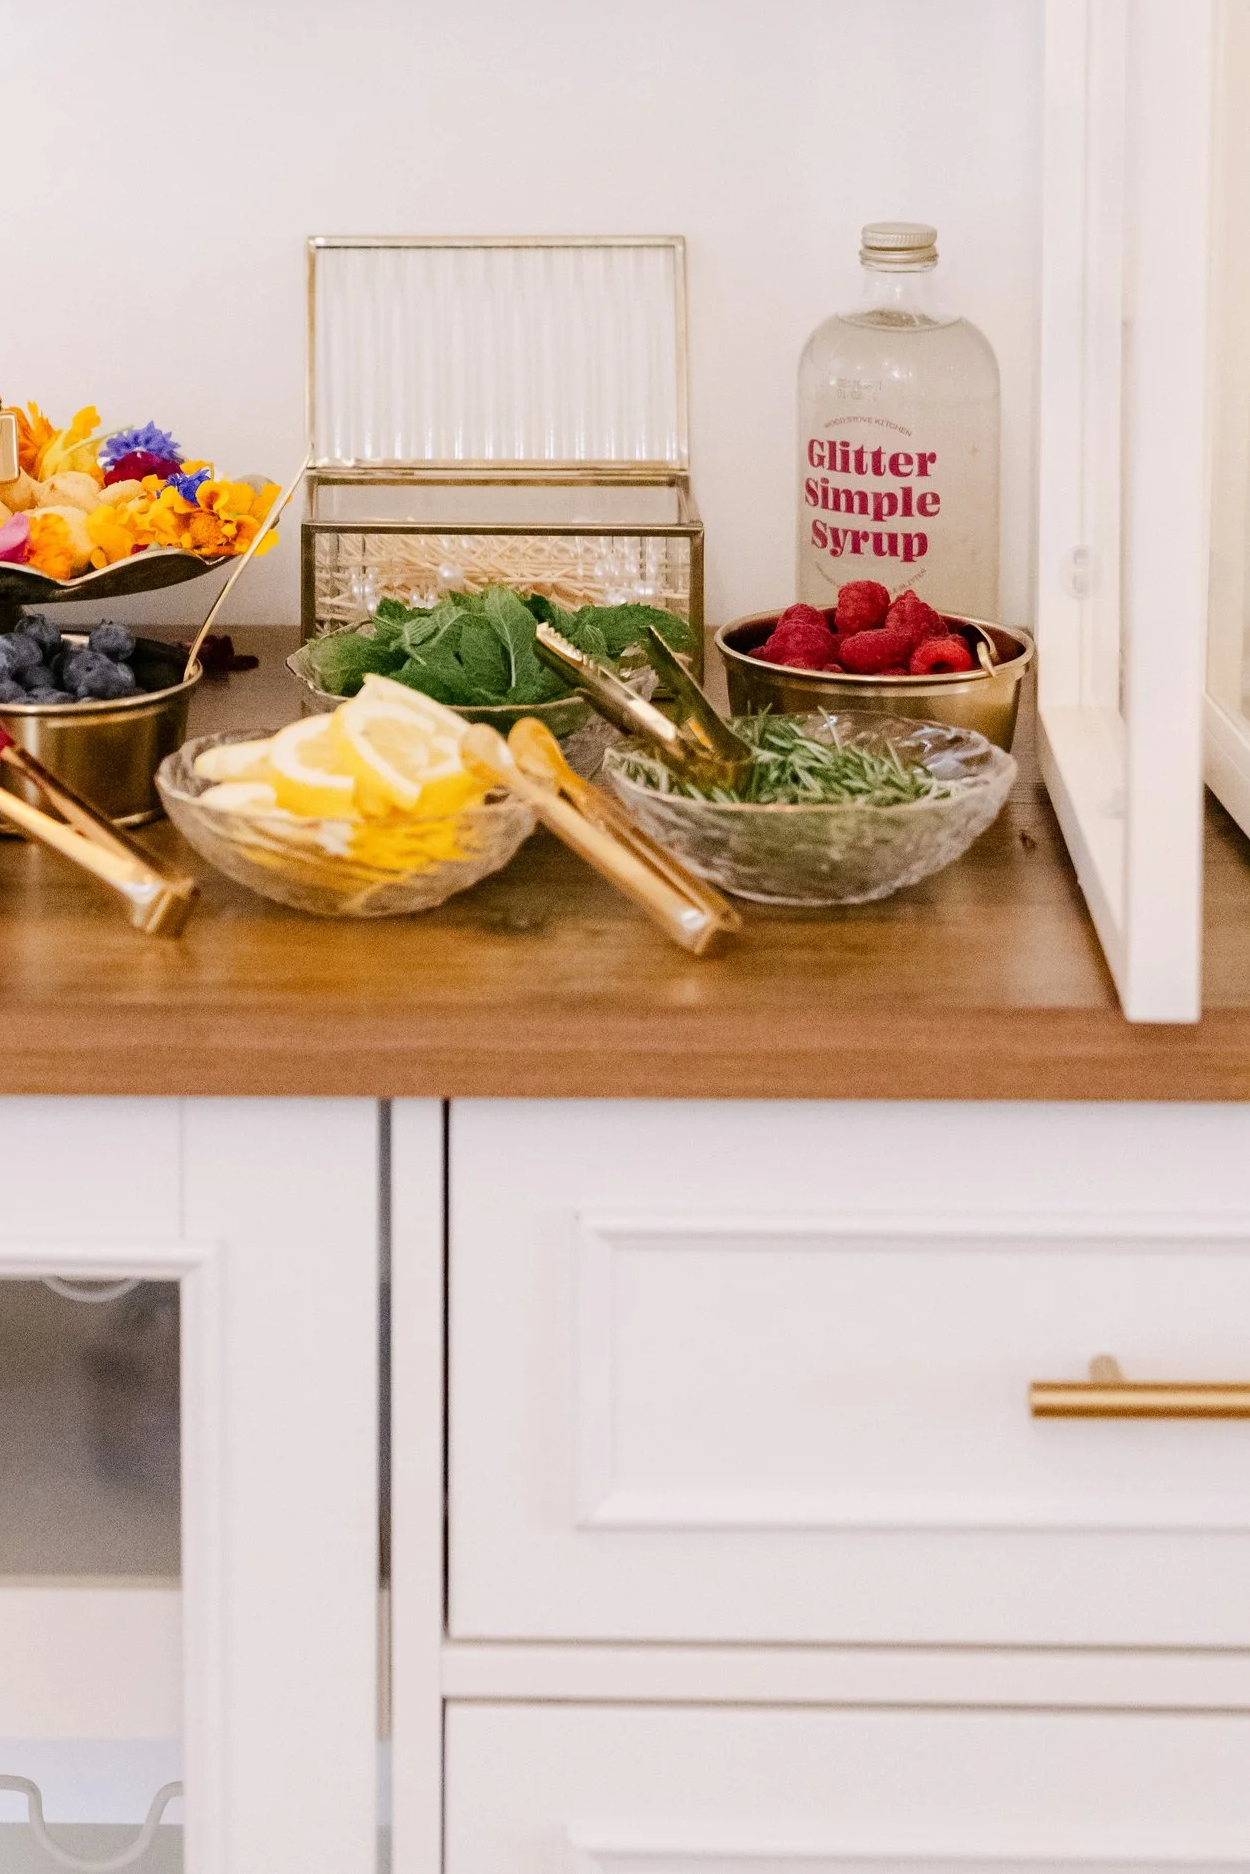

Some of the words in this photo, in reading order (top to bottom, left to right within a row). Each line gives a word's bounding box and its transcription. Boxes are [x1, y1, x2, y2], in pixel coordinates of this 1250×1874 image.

[846, 416, 873, 424] STOVE
[874, 418, 912, 437] KITCHEN
[807, 438, 937, 477] Glitter
[805, 477, 941, 522] Simple
[811, 518, 929, 563] Syrup
